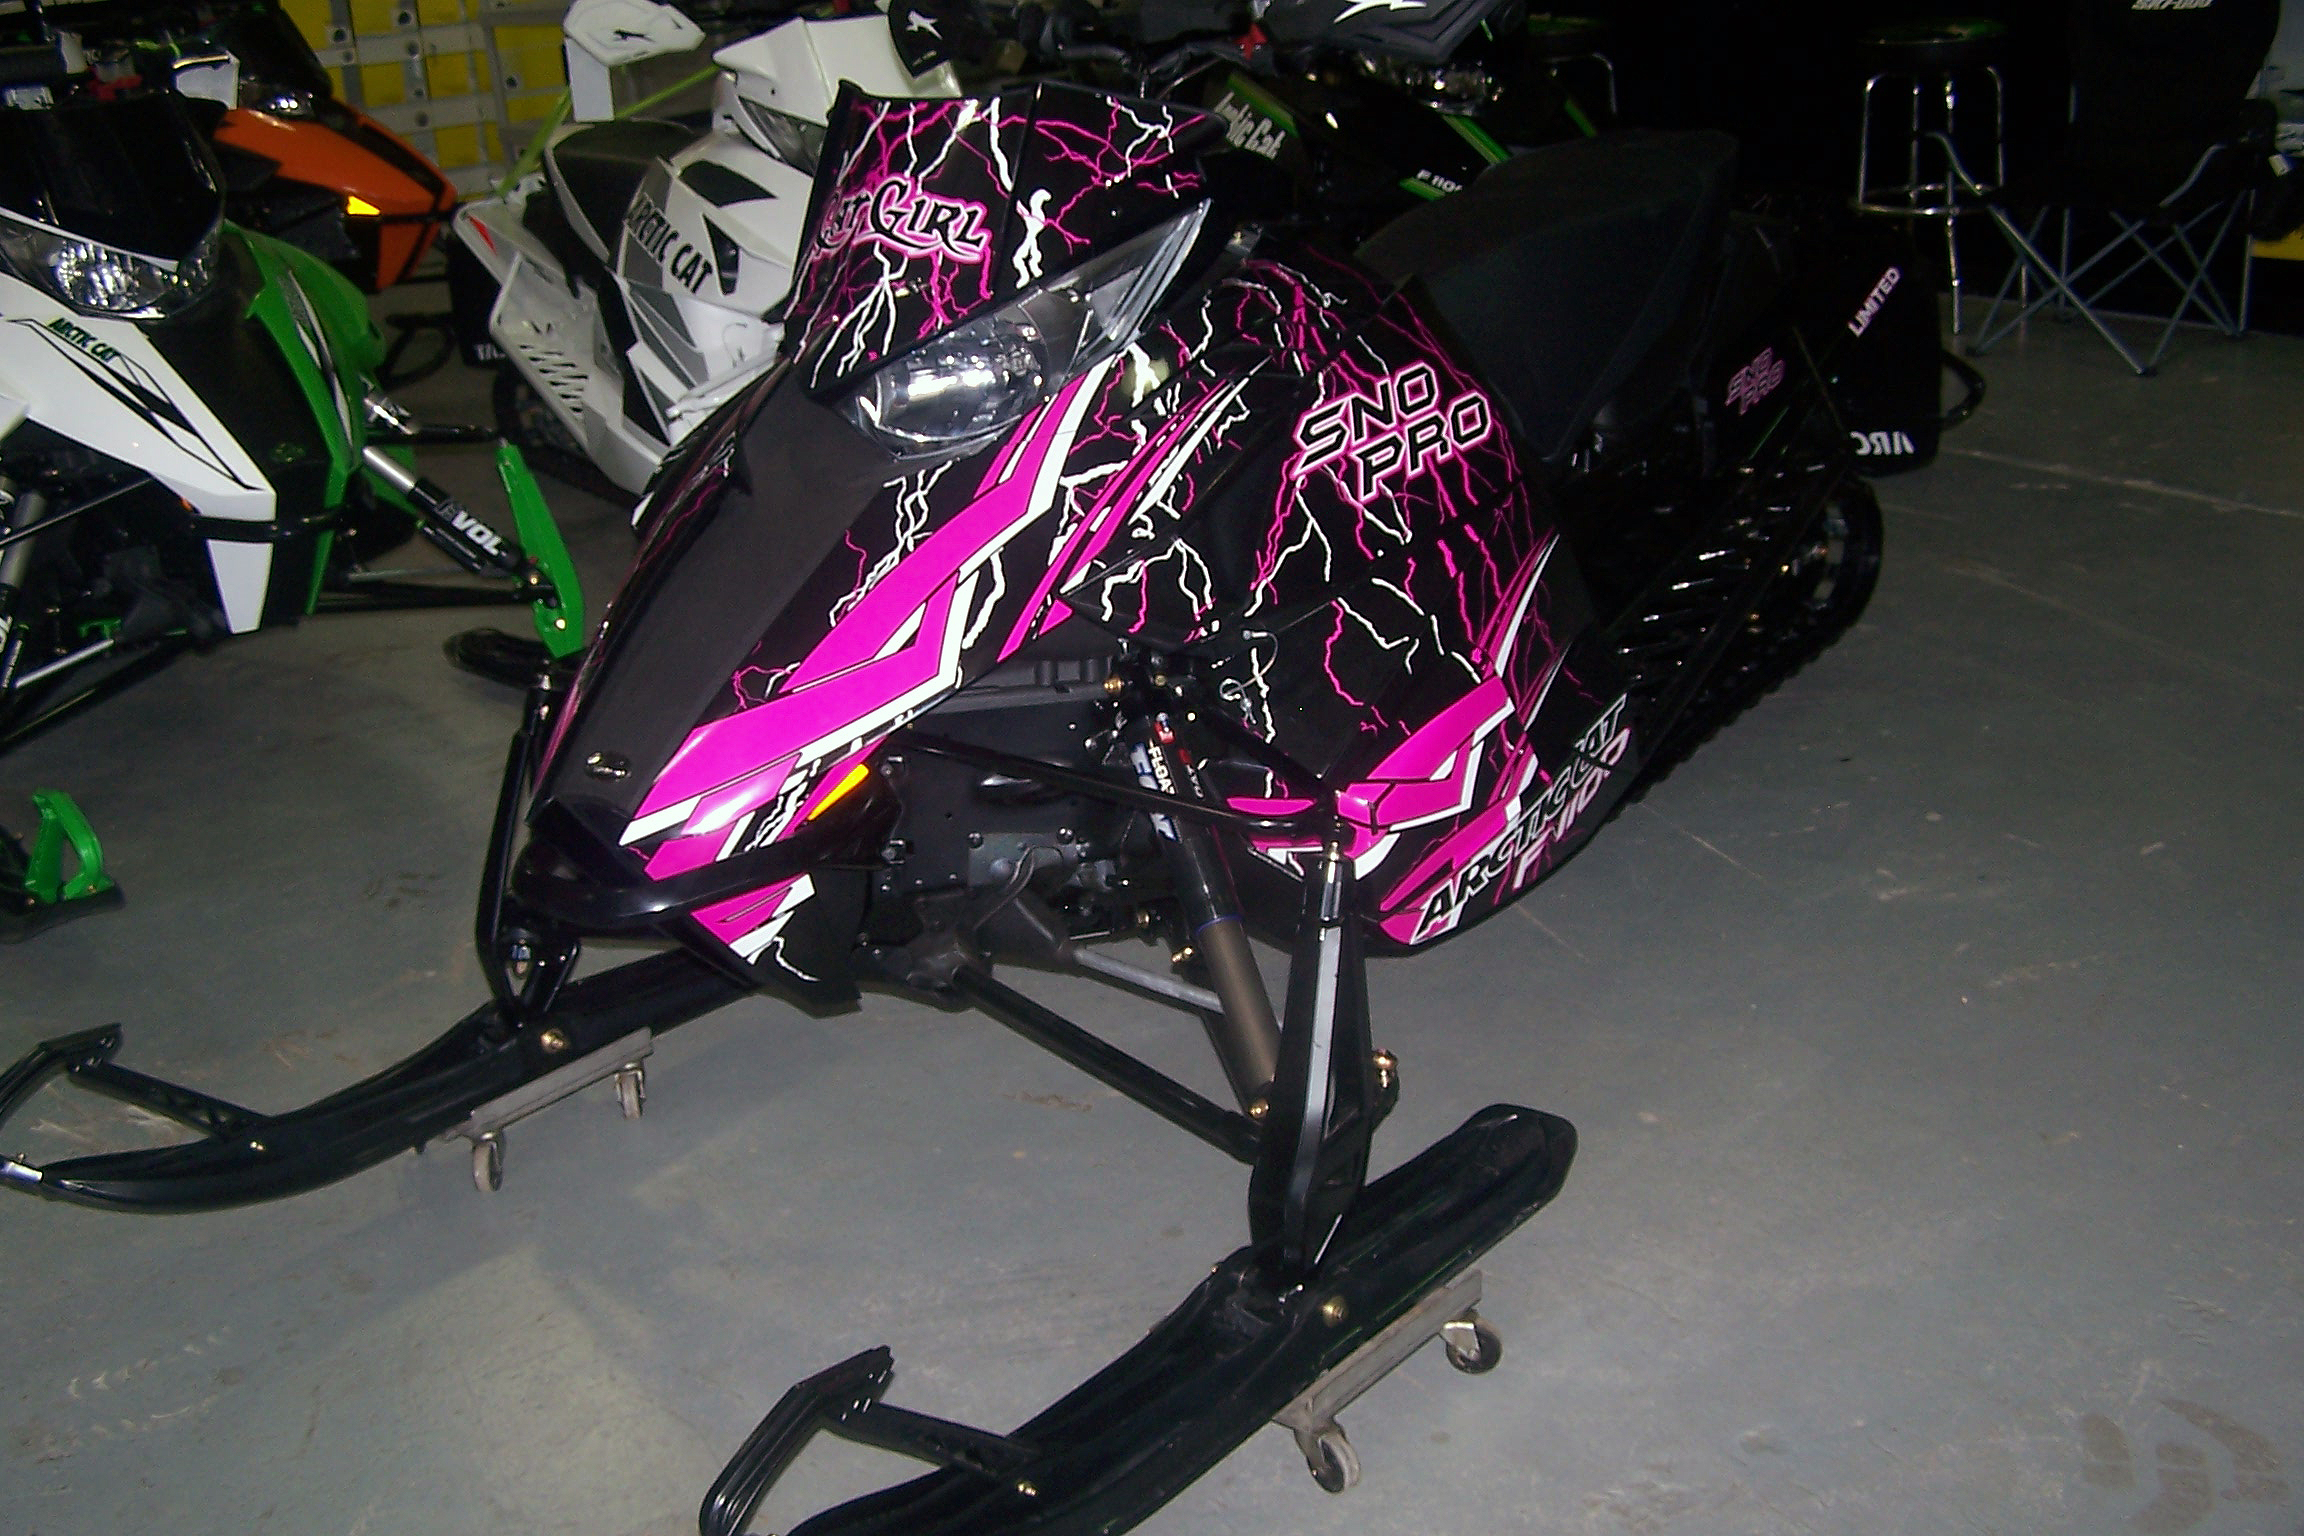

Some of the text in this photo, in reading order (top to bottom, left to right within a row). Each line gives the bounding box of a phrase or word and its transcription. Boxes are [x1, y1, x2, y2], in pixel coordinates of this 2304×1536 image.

[869, 177, 990, 258] GIRL
[671, 243, 713, 294] CAT
[1848, 266, 1901, 338] LIMITED
[47, 318, 121, 363] ARCTIC CAT
[1292, 363, 1438, 476] SNO
[1349, 392, 1491, 503] PRO
